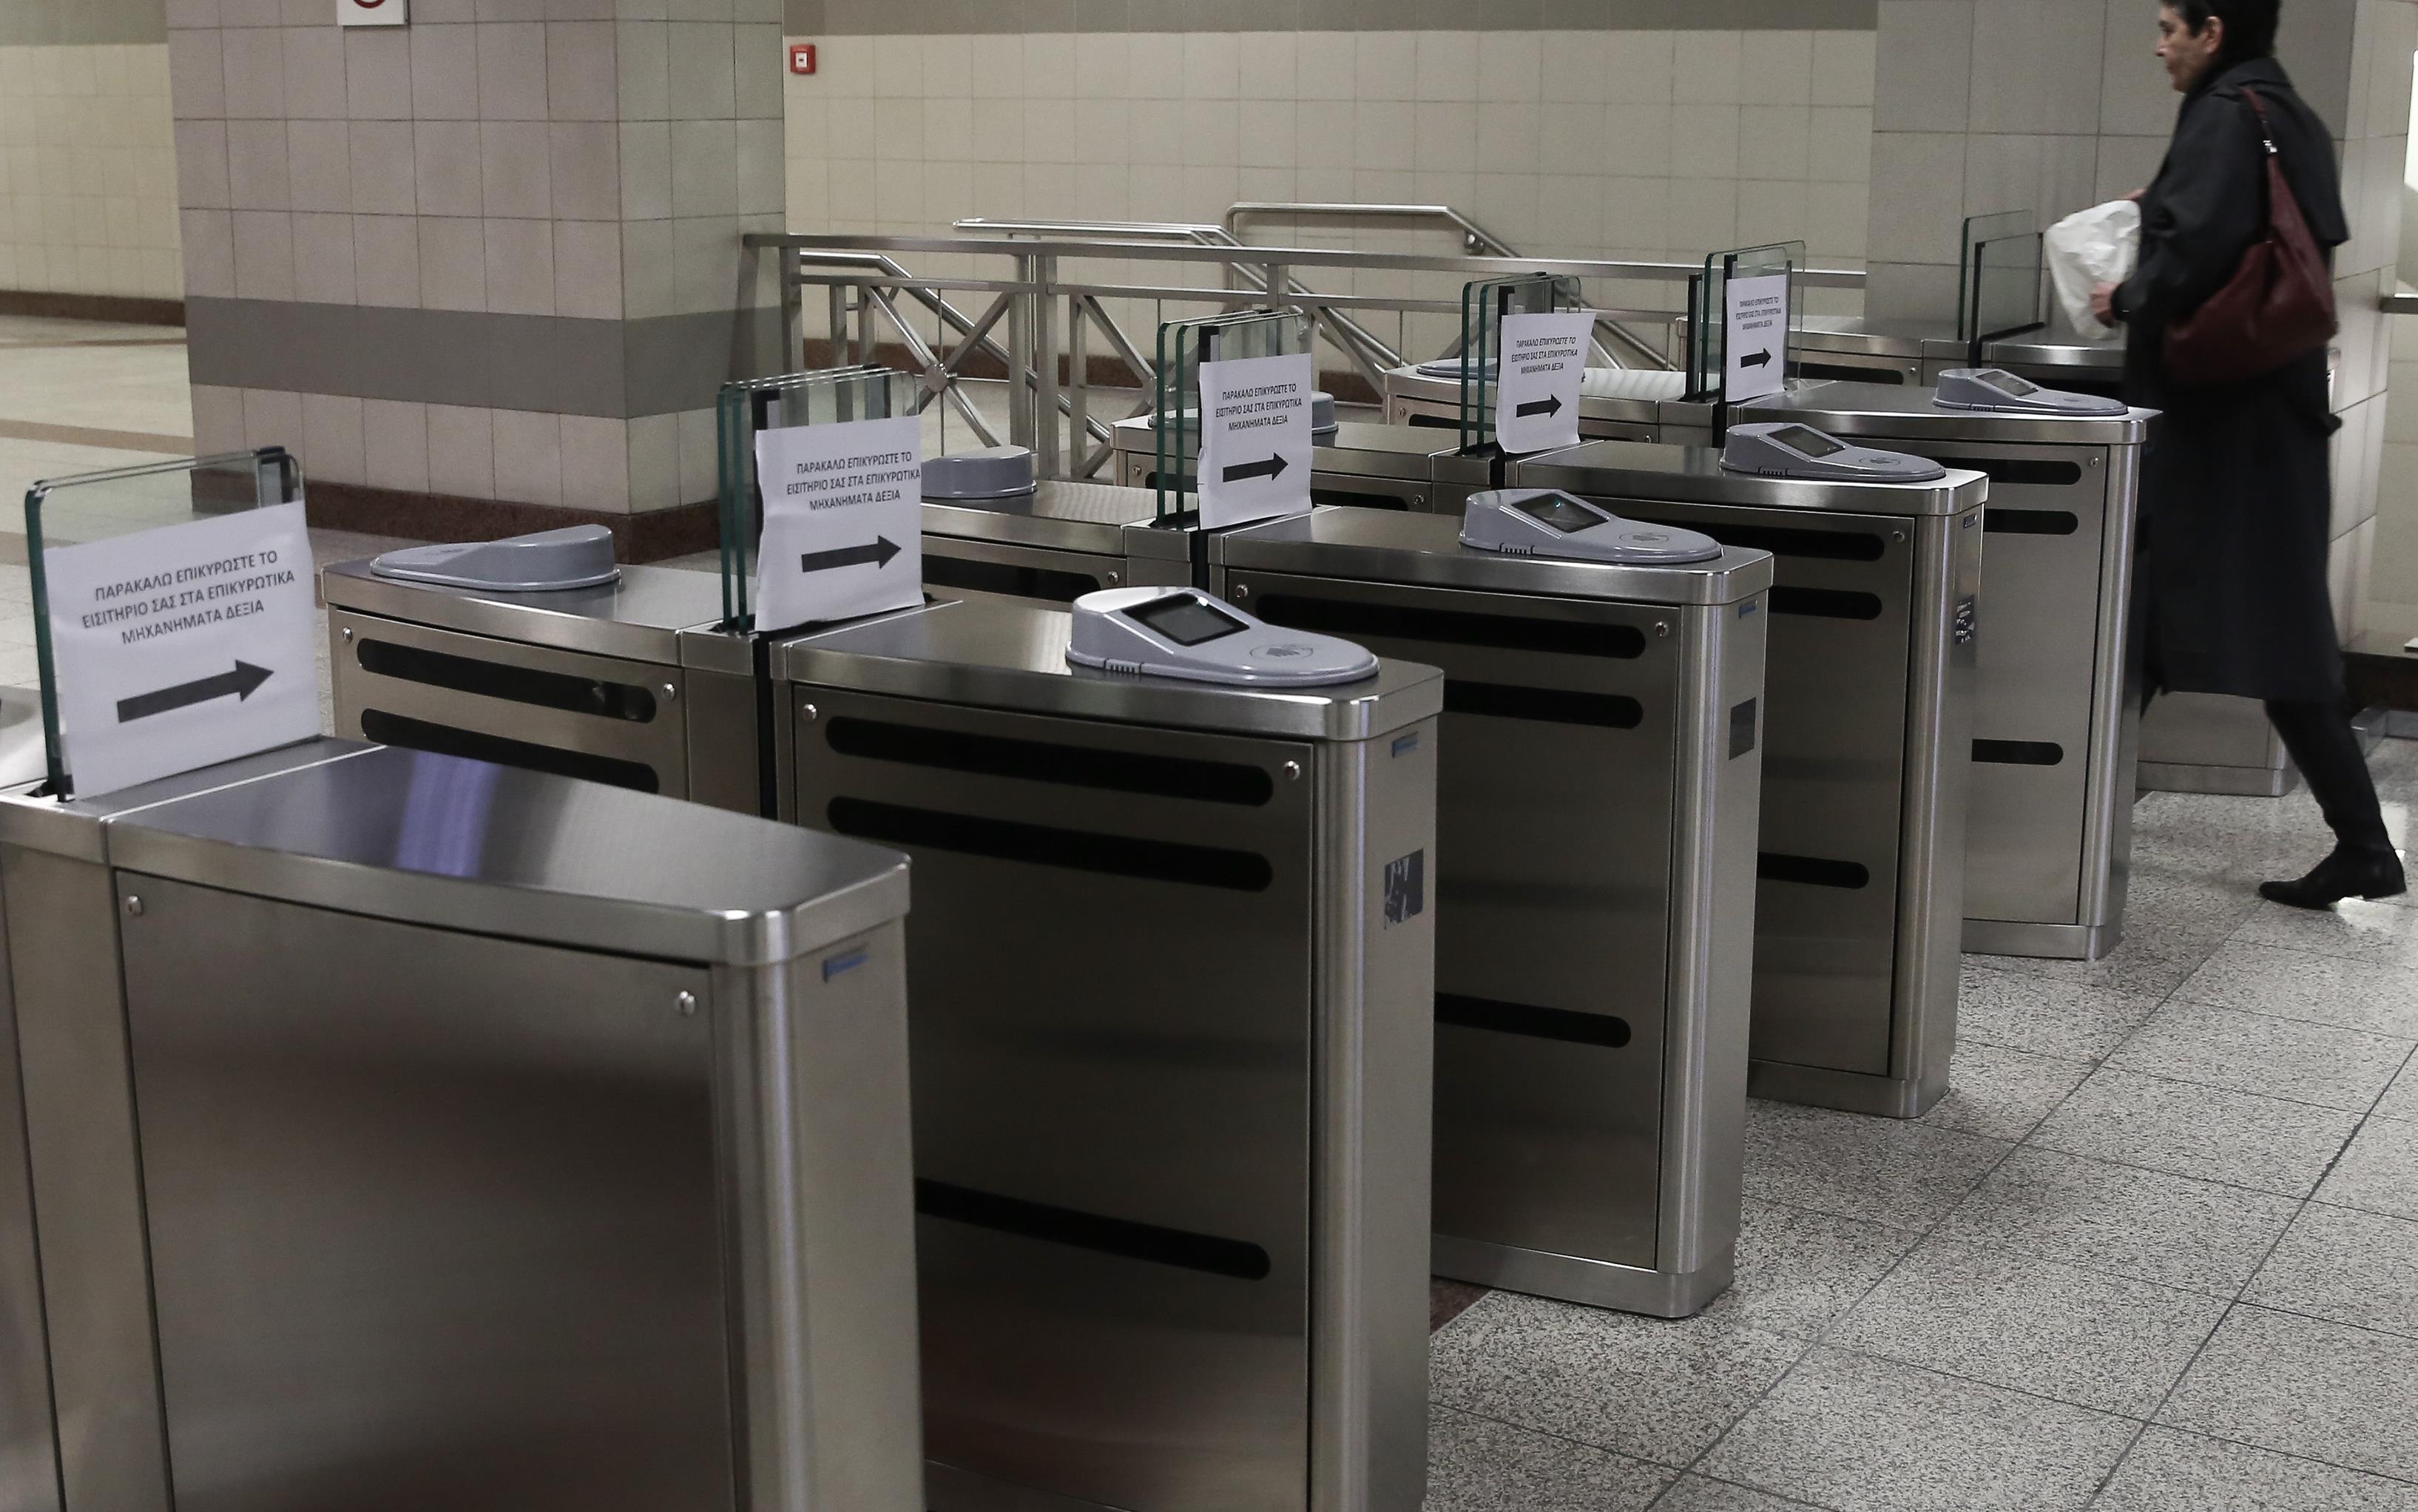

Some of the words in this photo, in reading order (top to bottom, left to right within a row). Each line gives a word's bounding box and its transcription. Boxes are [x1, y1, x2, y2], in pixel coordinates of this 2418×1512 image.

[1223, 388, 1253, 400] ΠΑΡΑΚΑΛΩ
[1254, 385, 1288, 396] ΕΠΙΚΥΡΩΣΤΕ
[1216, 405, 1242, 417] ΕΙΣΙΤΗΡΙΟ
[1243, 404, 1254, 414] ΣΑΣ
[1254, 403, 1265, 412] ΣΤΑ
[1266, 398, 1302, 411] ΕΠΙΚΥΡΩΤΙΚΑ
[1229, 417, 1271, 431] ΜΗΧΑΝΗΜΑΤΑ
[1272, 415, 1288, 425] ΔΕΞΙΑ
[797, 459, 845, 473] ΠΑΡΑΚΑΛΩ
[848, 453, 899, 468] ΕΠΙΚΥΡΩΣΤΕ
[901, 451, 911, 462] ΤΟ
[787, 480, 828, 494] ΕΙΣΙΤΗΡΙΟ
[831, 478, 846, 489] ΣΑΣ
[848, 476, 863, 487] ΣΤΑ
[866, 469, 920, 485] ΕΠΙΚΥΡΩΤΙΚΑ
[810, 493, 873, 510] ΜΗΧΑΝΗΜΑΤΑ
[875, 490, 900, 502] ΔΕΞΙΑ
[95, 573, 172, 601] ΠΑΡΑΚΑΛΩ
[177, 554, 255, 583] ΕΠΙΚΥΡΩΣΤΕ
[259, 550, 277, 564] ΤΟ
[83, 601, 148, 628] ΕΙΣΙΤΗΡΙΟ
[152, 595, 177, 612] ΣΑΣ
[180, 592, 204, 607] ΣΤΑ
[209, 570, 294, 600] ΕΠΙΚΥΡΩΤΙΚΑ
[123, 609, 222, 644] ΜΗΧΑΝΗΜΑΤΑ
[226, 600, 264, 618] ΔΕΞΙΑ
